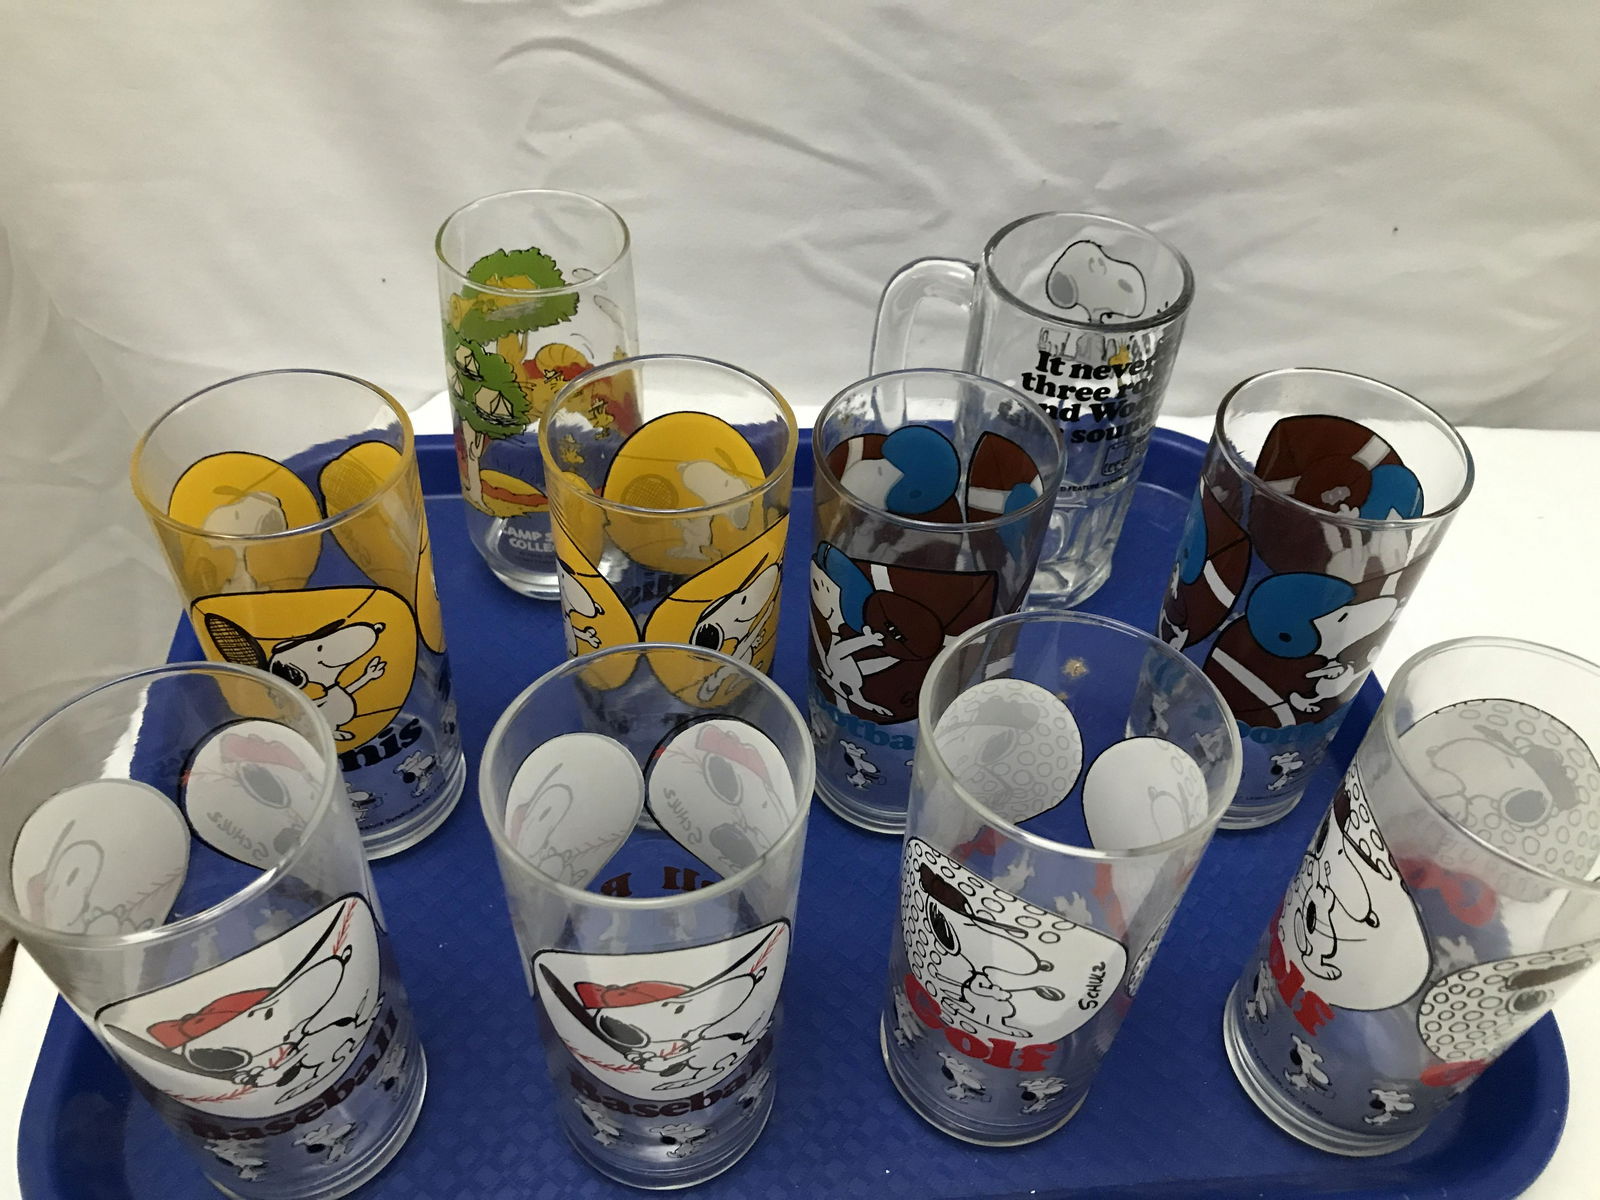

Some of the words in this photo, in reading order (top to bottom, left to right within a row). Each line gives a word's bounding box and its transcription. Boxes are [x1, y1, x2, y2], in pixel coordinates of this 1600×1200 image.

[1036, 350, 1066, 375] It
[1069, 355, 1156, 380] never
[1022, 372, 1110, 401] three
[1077, 960, 1106, 1012] SCHULZ
[904, 973, 1059, 1072] Golf
